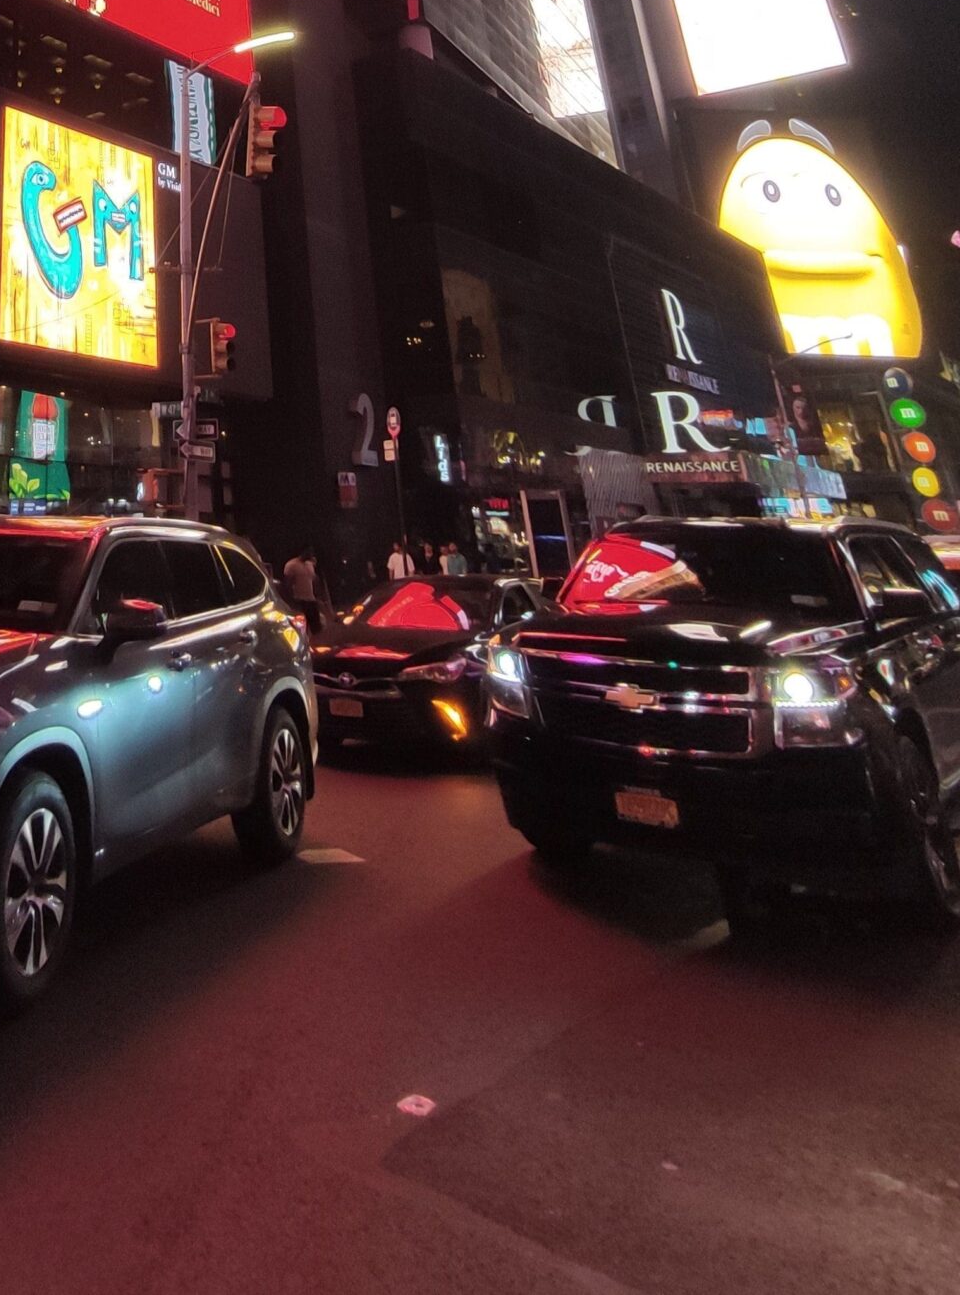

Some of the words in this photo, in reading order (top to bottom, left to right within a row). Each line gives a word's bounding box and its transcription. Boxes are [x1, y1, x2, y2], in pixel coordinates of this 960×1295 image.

[157, 162, 176, 179] GM
[660, 288, 703, 365] R
[349, 393, 379, 468] 2
[650, 390, 731, 454] R
[646, 458, 740, 474] RENAISSANCE
